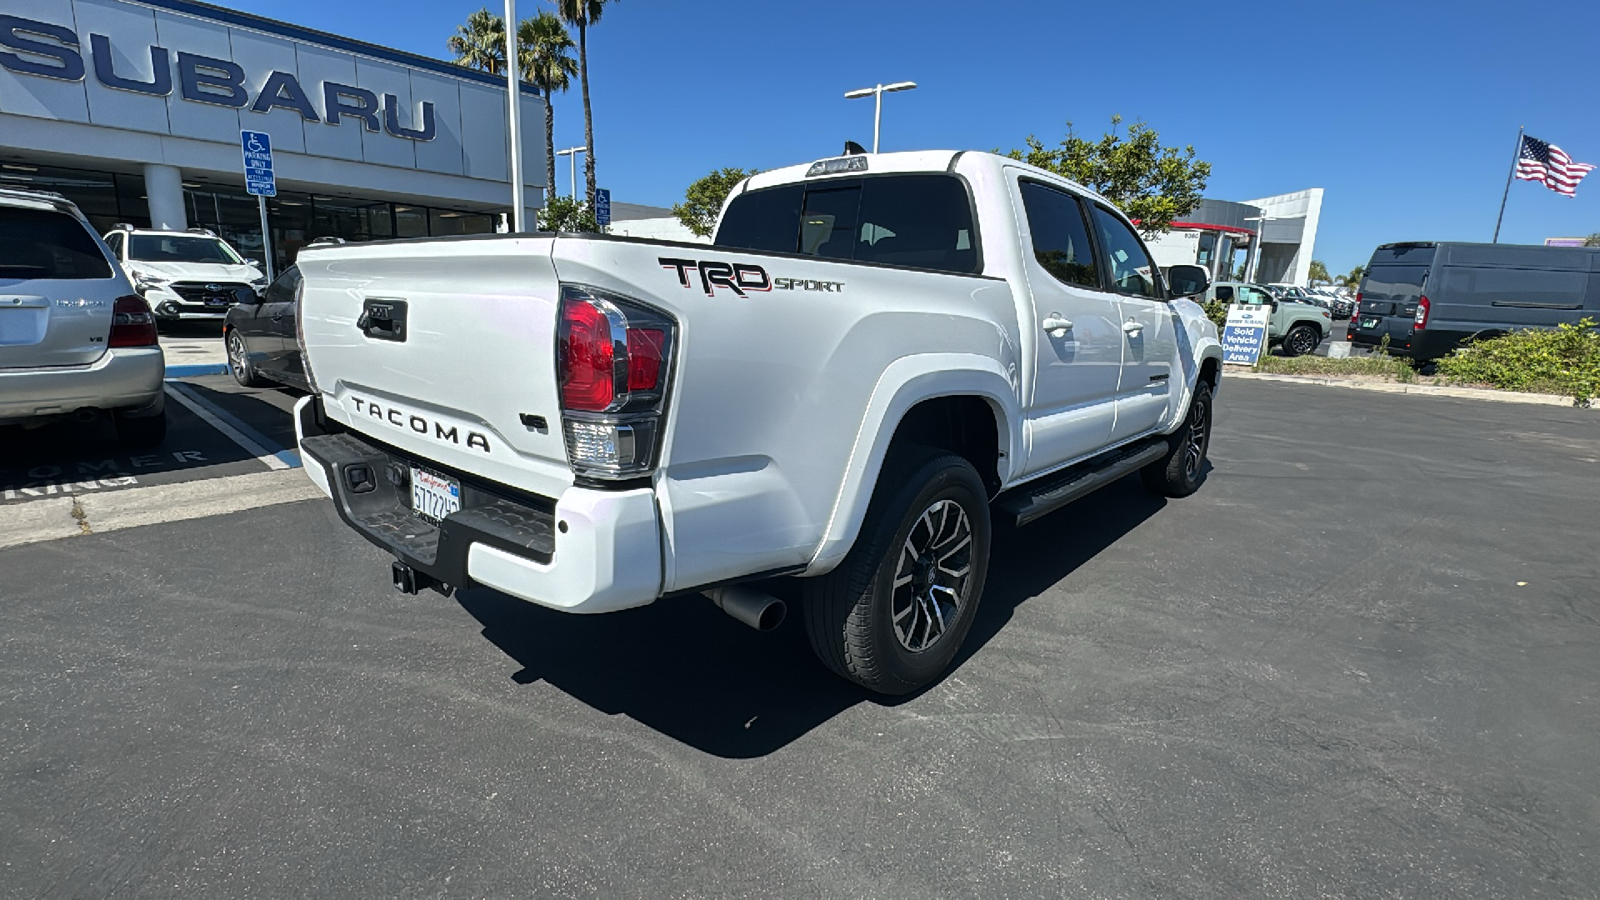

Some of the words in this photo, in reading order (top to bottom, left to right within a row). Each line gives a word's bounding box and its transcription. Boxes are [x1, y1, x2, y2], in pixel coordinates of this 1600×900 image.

[0, 14, 436, 141] SUBARU
[245, 151, 270, 161] PARKING
[251, 160, 266, 168] ONLY
[658, 257, 772, 298] TRD
[774, 277, 846, 293] SPORT
[1233, 327, 1255, 336] Sold
[1226, 335, 1258, 345] Vehicle
[1222, 343, 1258, 354] Delivery
[1228, 353, 1250, 362] Area
[351, 396, 491, 453] TACOMA
